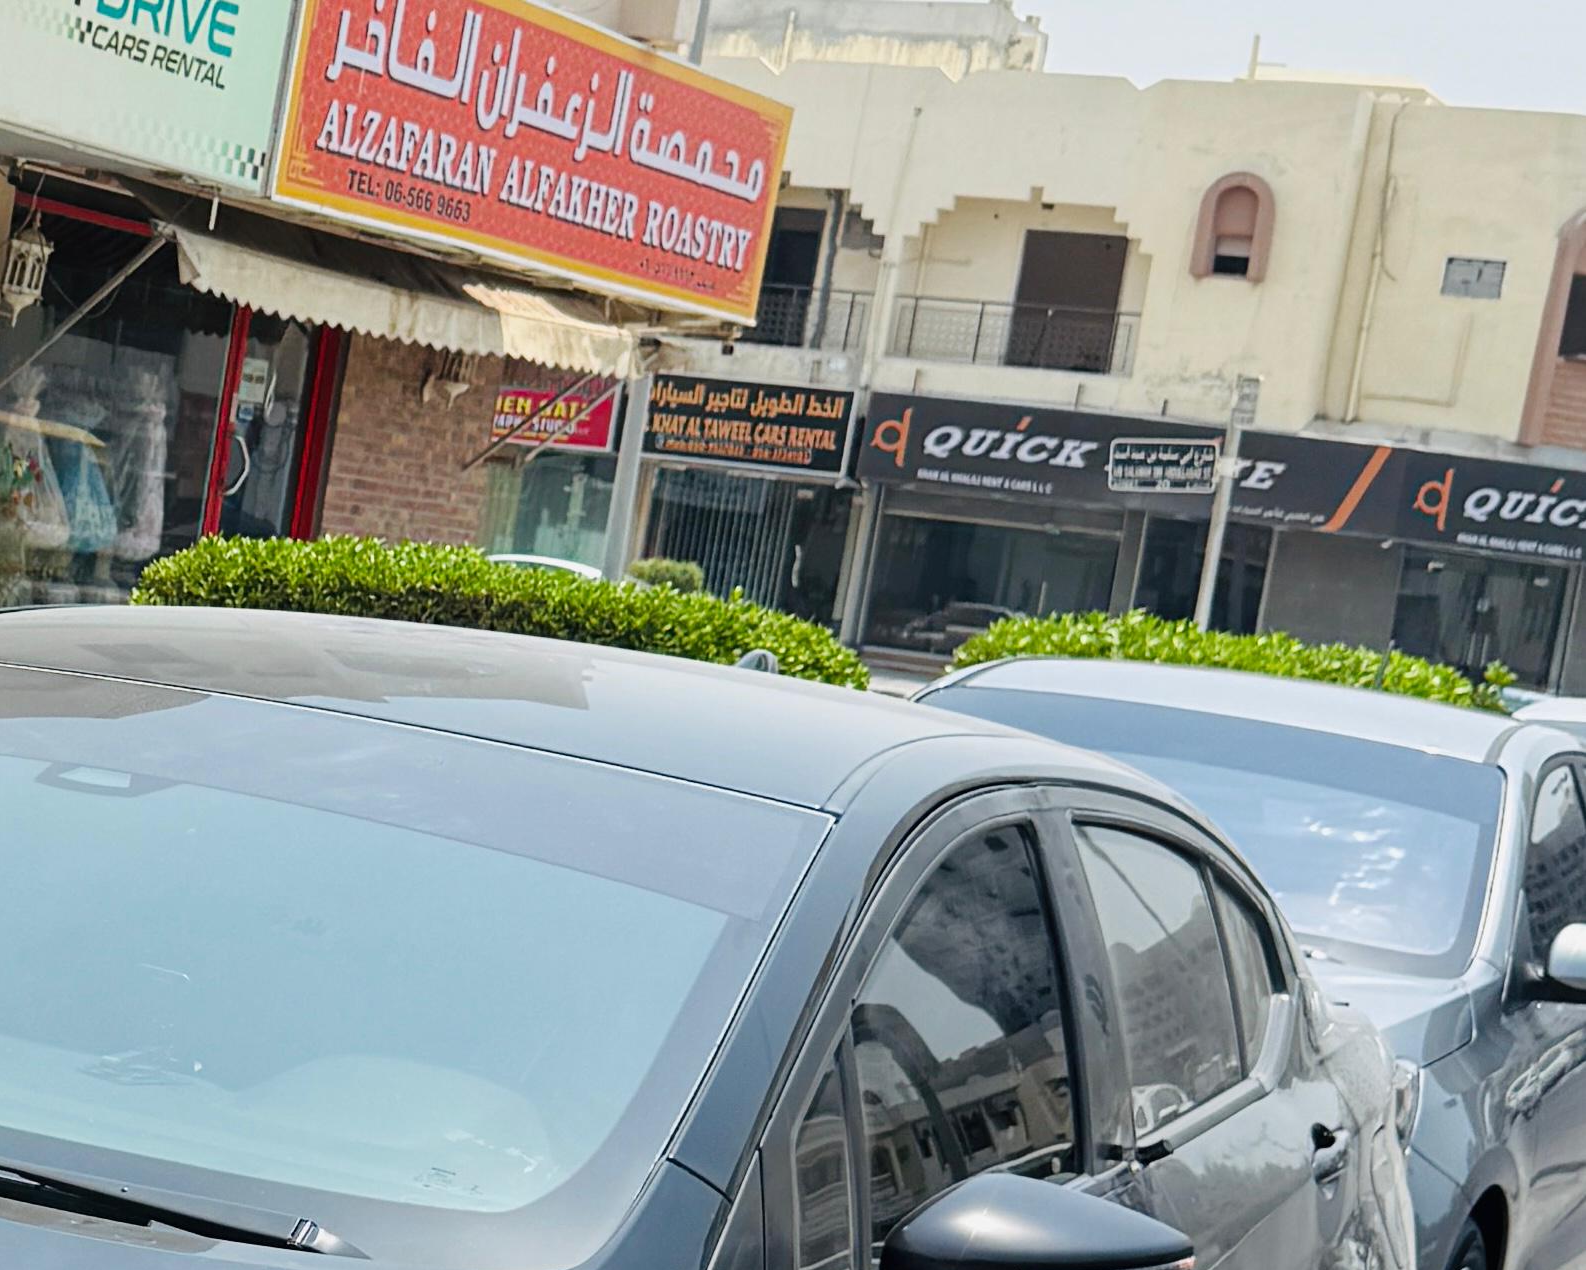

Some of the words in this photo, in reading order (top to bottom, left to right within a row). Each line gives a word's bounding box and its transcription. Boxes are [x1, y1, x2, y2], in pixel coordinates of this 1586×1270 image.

[91, 25, 147, 63] CARS
[150, 44, 225, 90] RENTAL
[325, 0, 483, 105] الفاخر
[477, 27, 635, 162] الزعفران
[316, 99, 497, 197] ALZAFARAN
[499, 155, 640, 240] ALFAKHER
[643, 204, 751, 272] ROASTRY
[629, 92, 765, 201] محمصة
[348, 169, 380, 197] TEL:
[437, 194, 471, 223] 9663
[703, 418, 752, 444] TAWEEL
[754, 422, 787, 447] CARS
[788, 426, 836, 450] RENTAL
[923, 416, 1098, 468] QUICK
